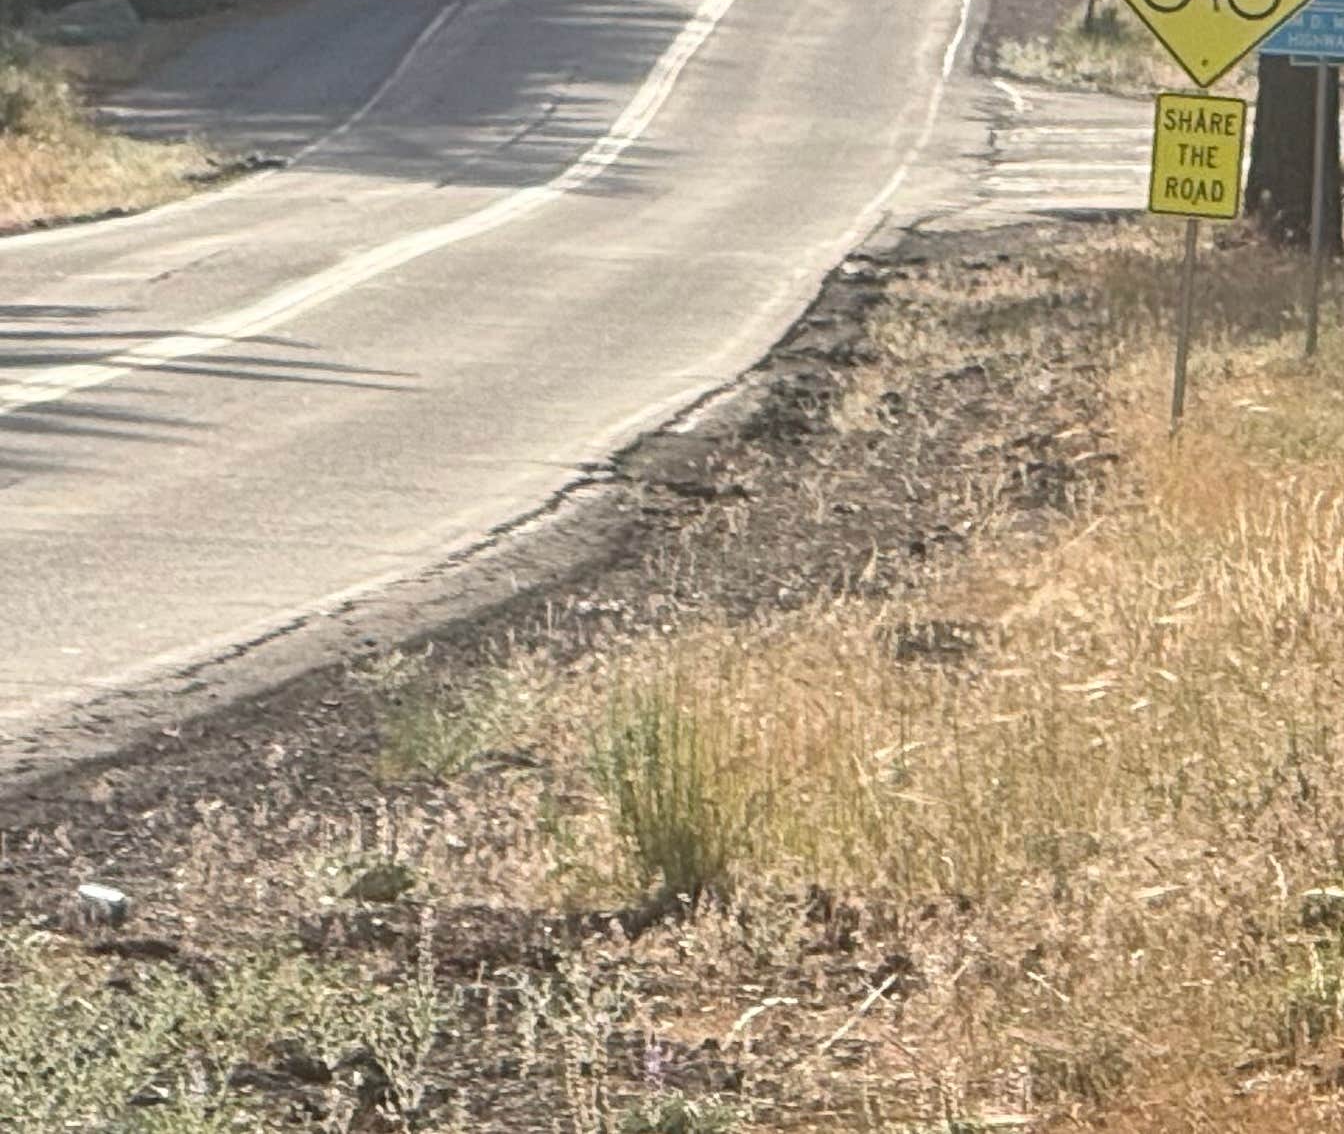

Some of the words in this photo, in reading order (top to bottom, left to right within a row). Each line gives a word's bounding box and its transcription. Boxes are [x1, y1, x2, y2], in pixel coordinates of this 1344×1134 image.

[1163, 108, 1237, 136] SHARE
[1178, 143, 1218, 168] THE
[1165, 176, 1224, 202] ROAD
